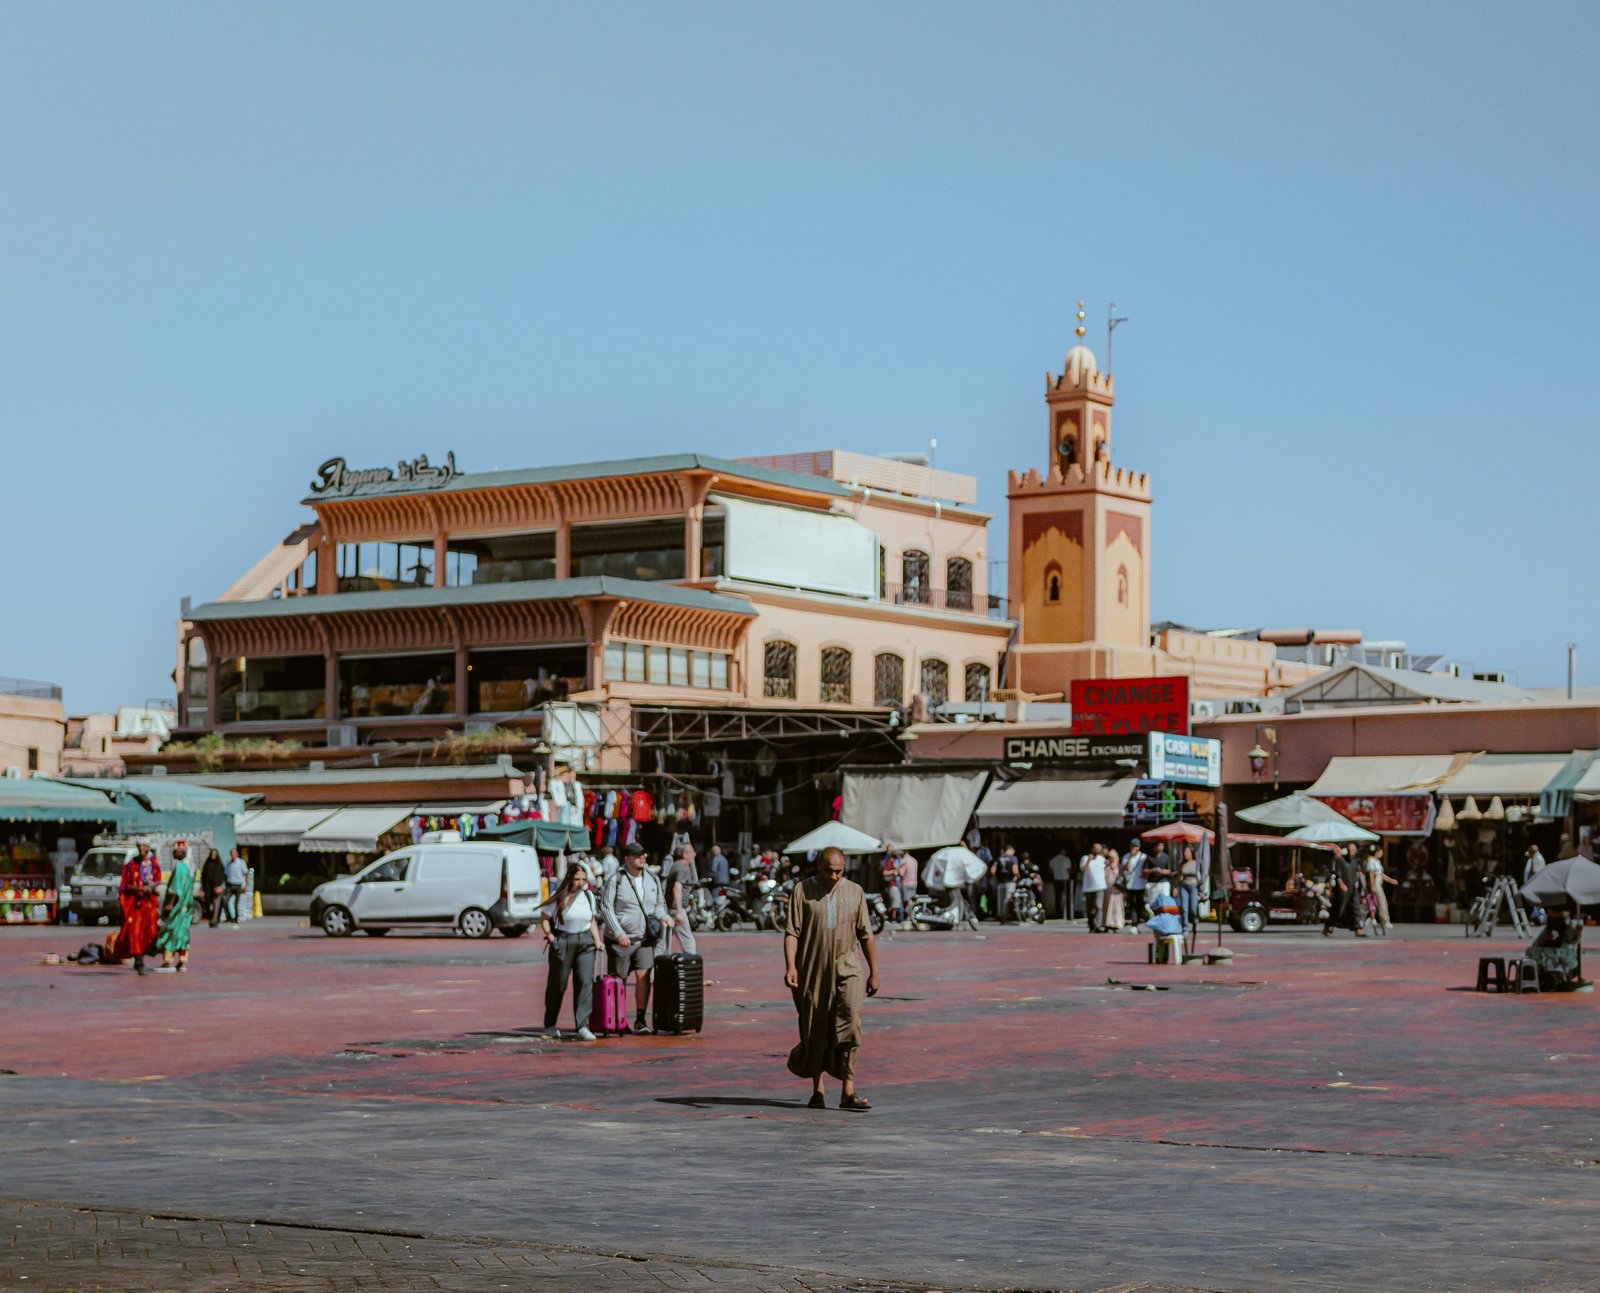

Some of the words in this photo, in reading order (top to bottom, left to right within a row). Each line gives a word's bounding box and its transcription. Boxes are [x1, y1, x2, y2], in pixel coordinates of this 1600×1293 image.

[310, 457, 393, 495] Argana
[1084, 684, 1174, 706] CHANGE
[1111, 713, 1180, 735] PLACE
[1007, 738, 1090, 758] CHANGE
[1091, 744, 1143, 756] EXCHANGE
